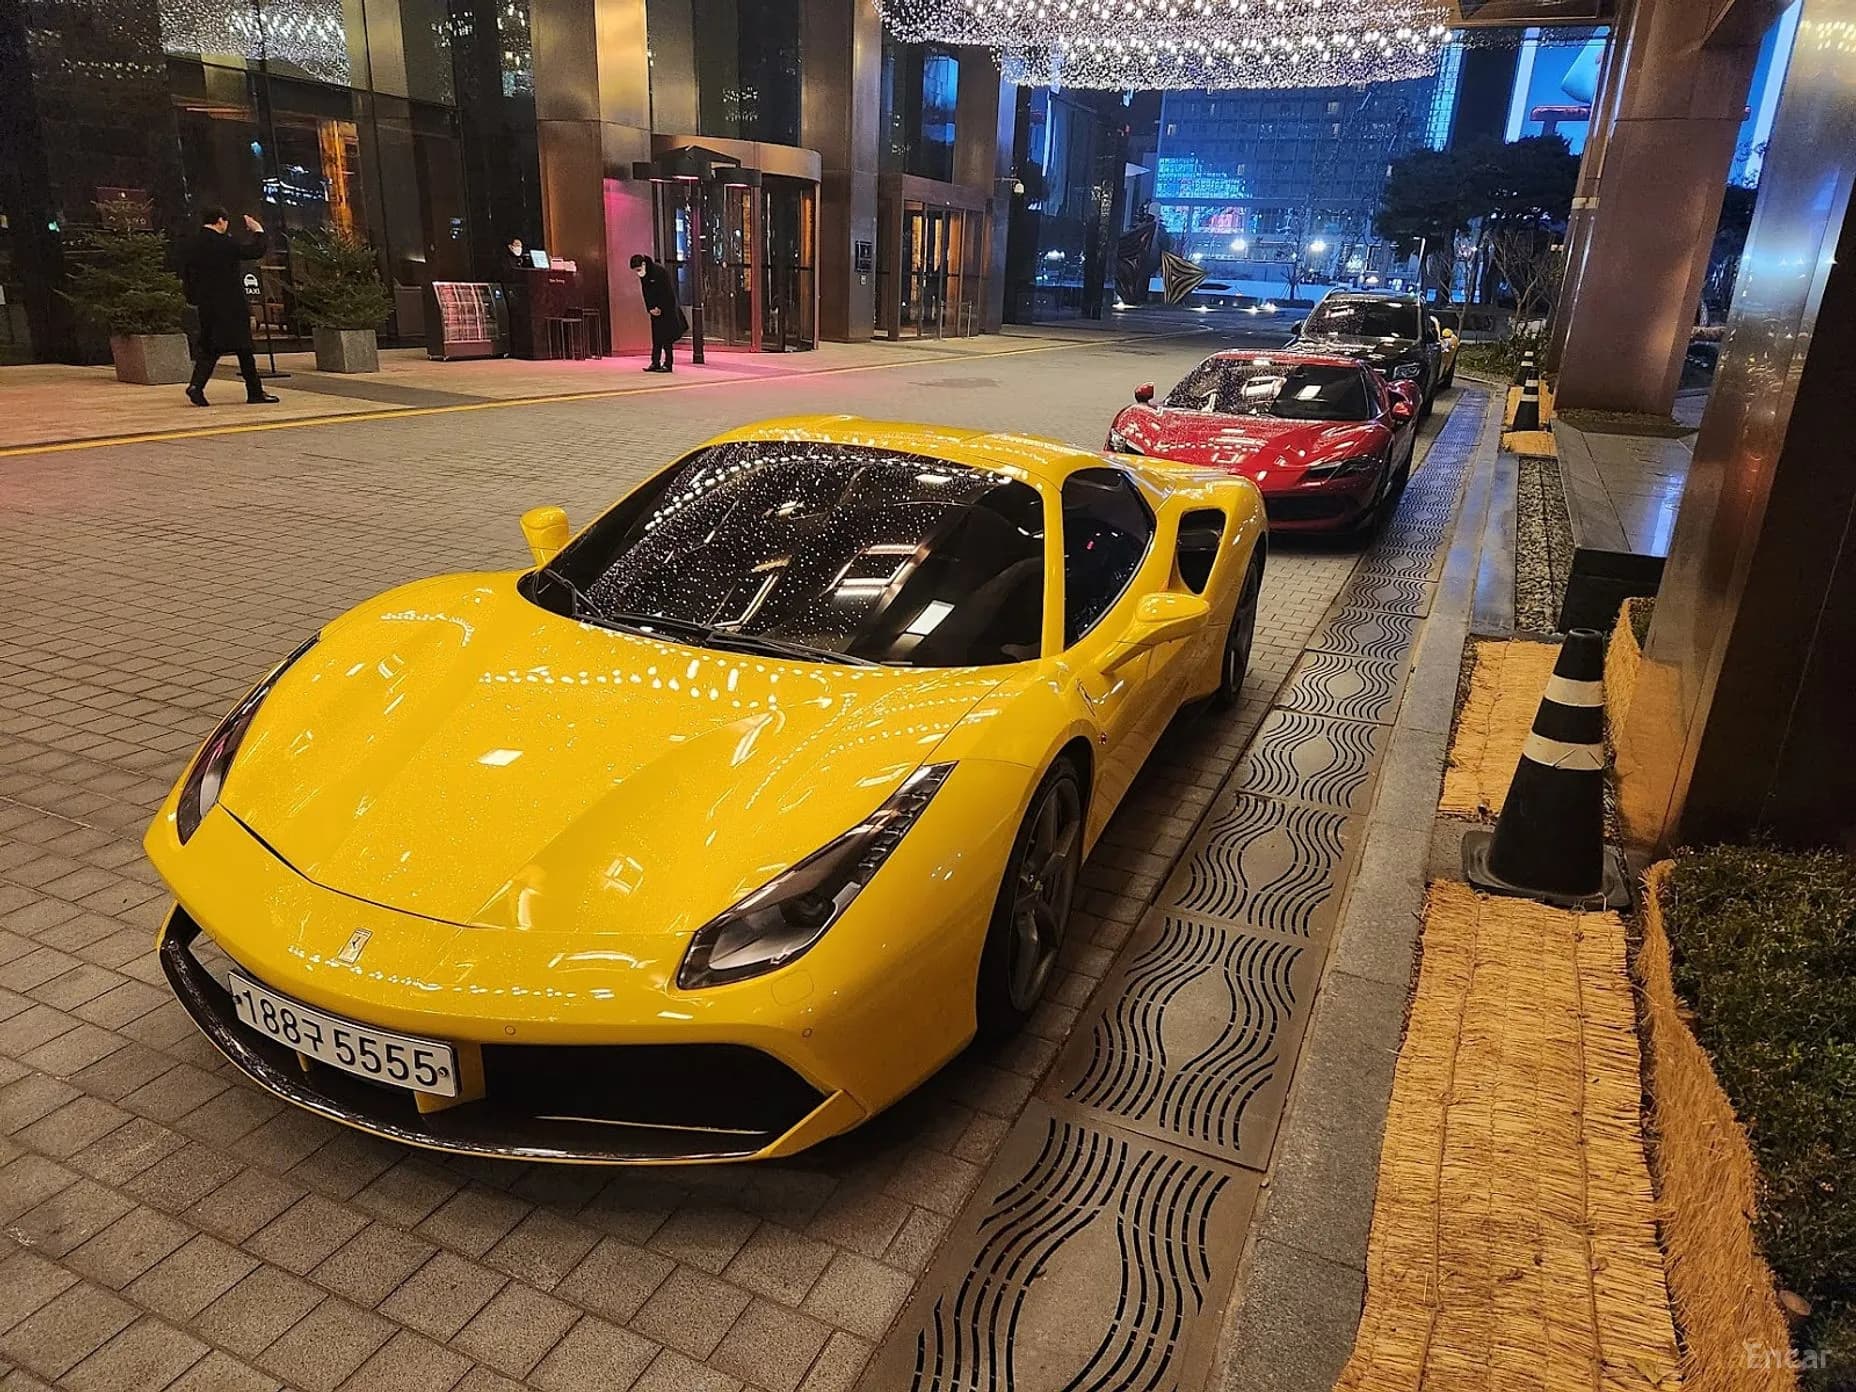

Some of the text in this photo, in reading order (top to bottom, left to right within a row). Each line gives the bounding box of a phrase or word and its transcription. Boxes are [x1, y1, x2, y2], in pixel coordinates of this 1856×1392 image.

[244, 287, 261, 295] TAXI
[242, 989, 438, 1087] 188구 5555
